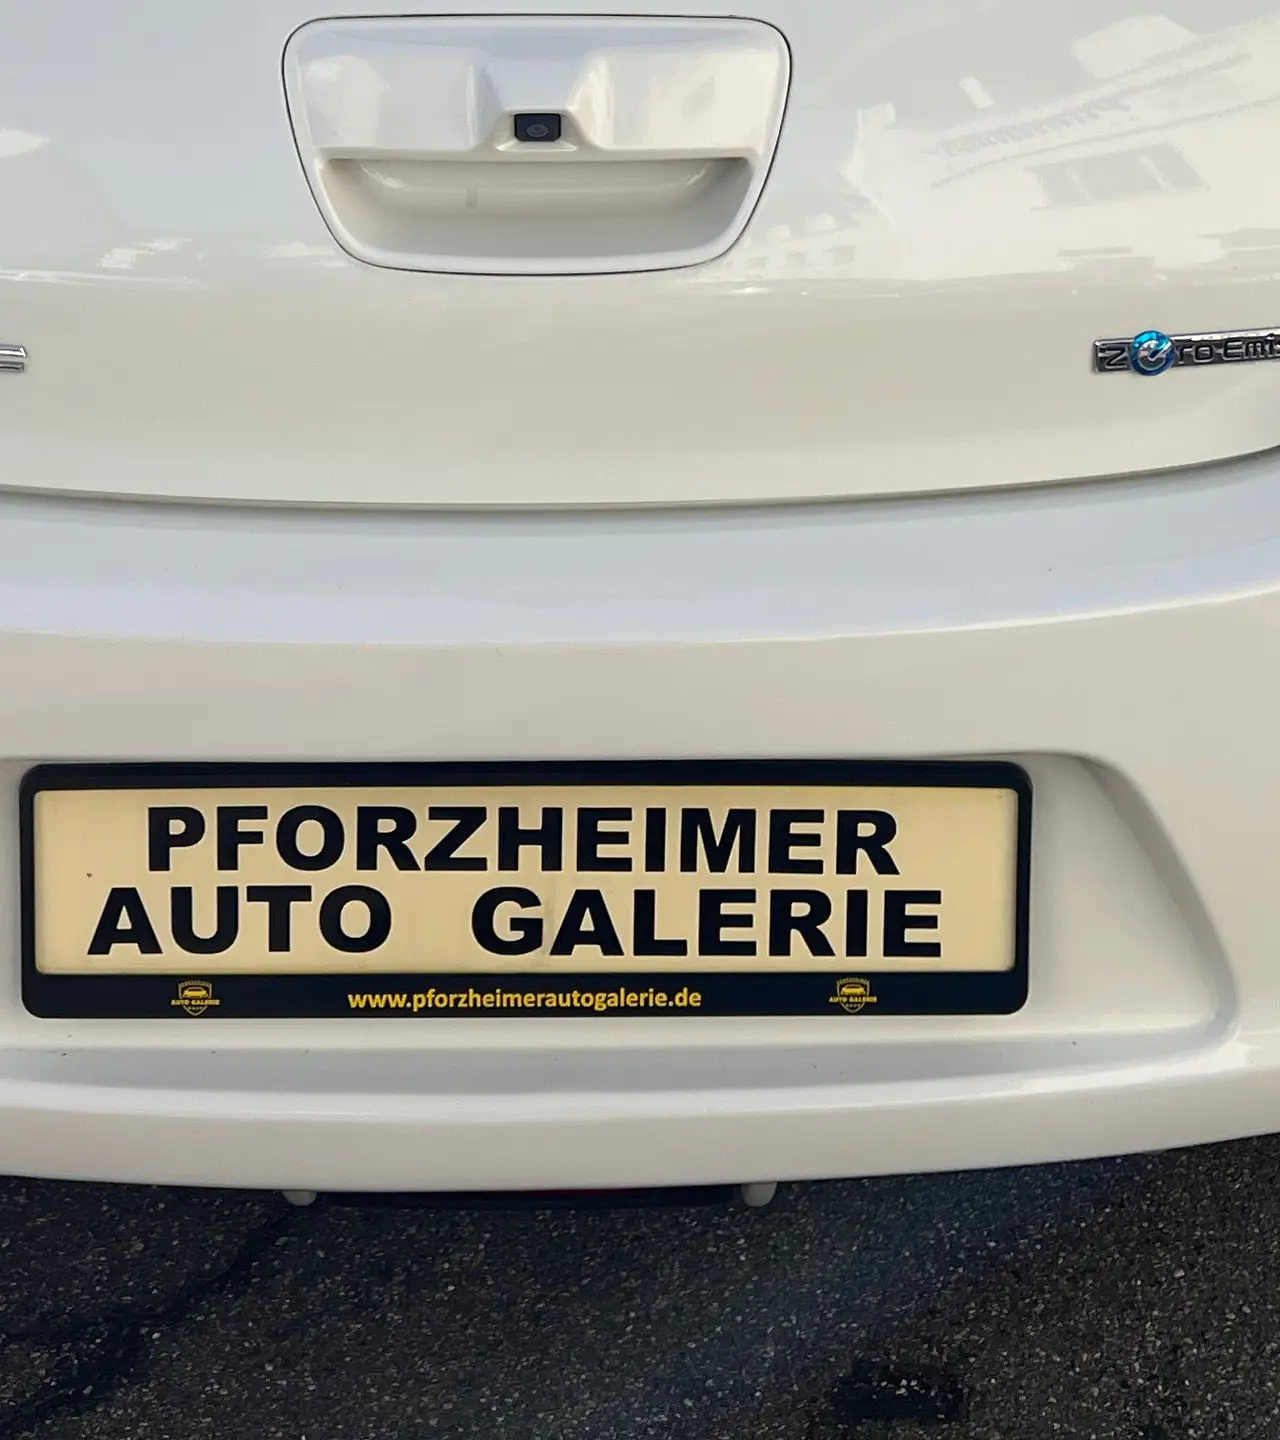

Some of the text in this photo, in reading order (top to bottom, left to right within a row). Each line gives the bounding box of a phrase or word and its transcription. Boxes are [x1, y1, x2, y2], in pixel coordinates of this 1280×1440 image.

[148, 805, 900, 876] PFORZHEIMER
[87, 884, 942, 958] AUTO GALERIE
[348, 987, 702, 1011] www.pforzheimerautogalerie.de
